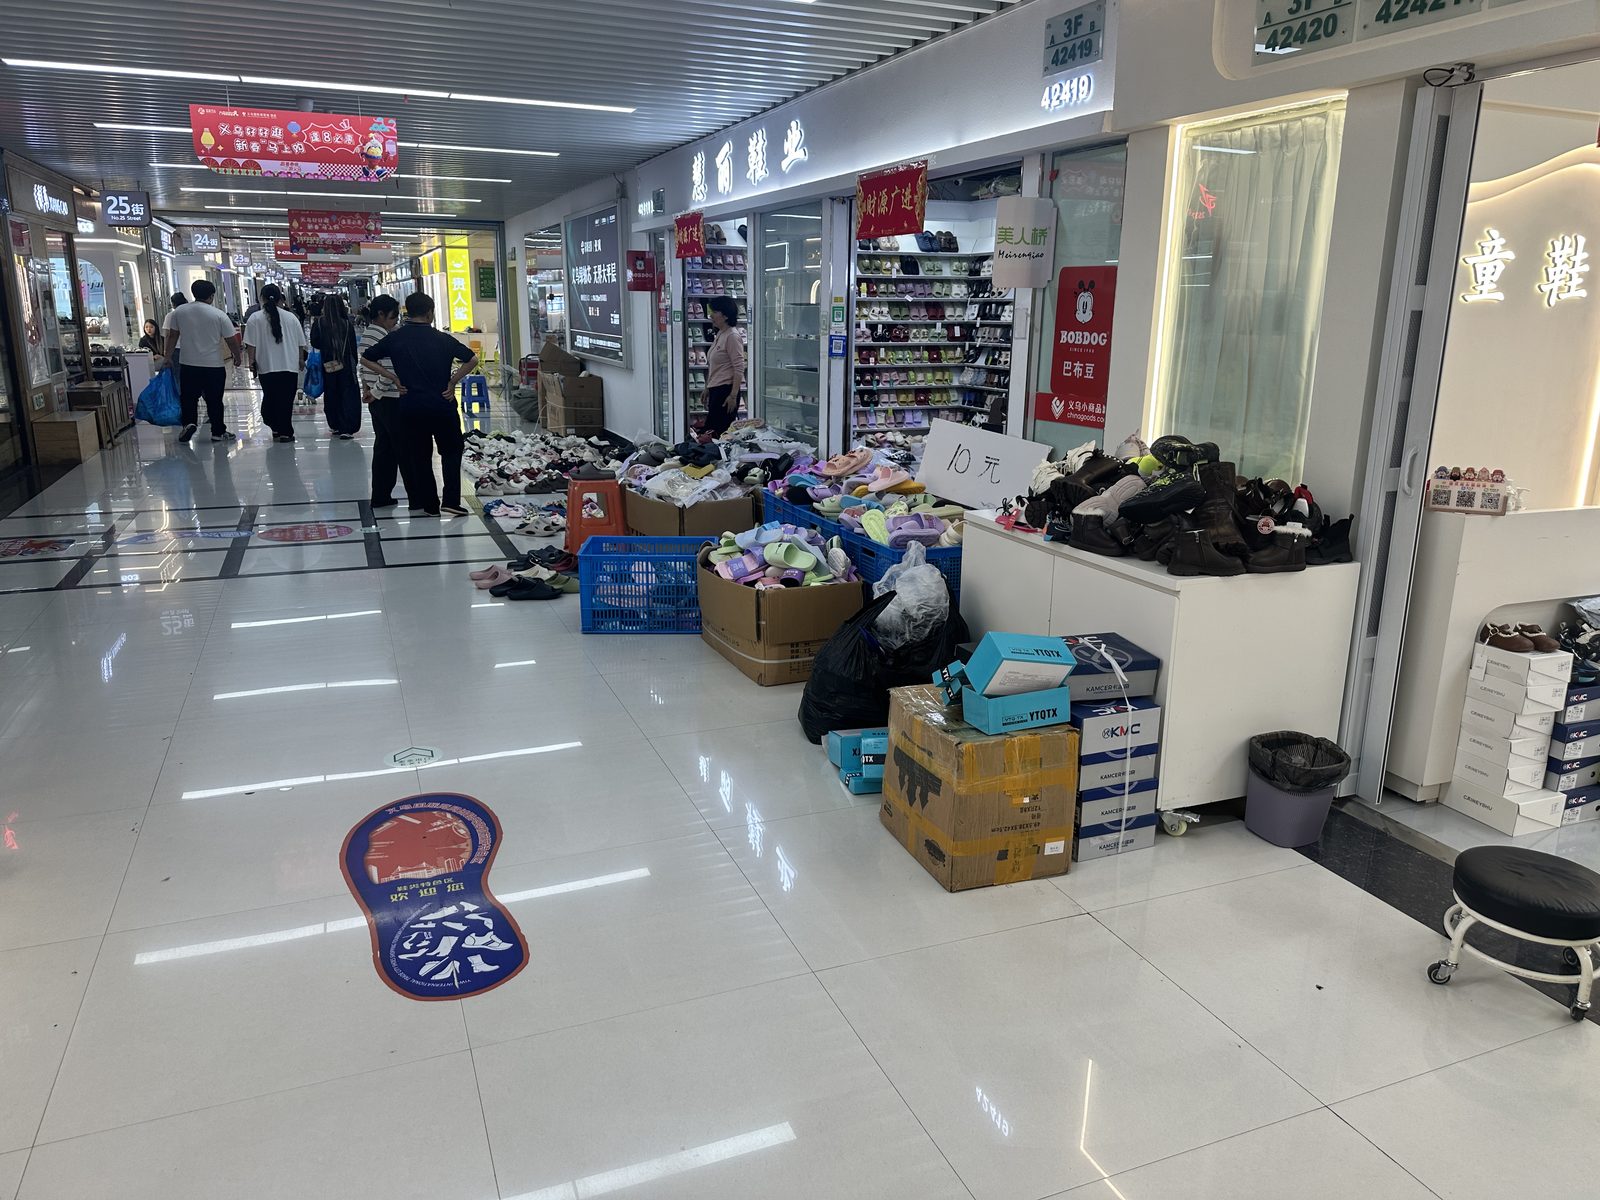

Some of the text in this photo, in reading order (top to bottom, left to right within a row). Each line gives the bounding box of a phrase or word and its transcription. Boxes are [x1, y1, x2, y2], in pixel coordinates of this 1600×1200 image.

[1264, 11, 1271, 25] A
[1049, 14, 1095, 46] A 3F B
[1265, 13, 1338, 52] 42420
[1051, 38, 1093, 67] 42419
[1041, 74, 1091, 111] 42419
[106, 195, 145, 216] 25街
[866, 182, 914, 218] 财源广进
[997, 226, 1048, 246] 美人桥
[1461, 228, 1590, 308] 童鞋
[1060, 330, 1108, 346] BOBDOG
[1063, 360, 1095, 379] 巴布豆
[1068, 400, 1105, 414] 义乌小商品
[947, 443, 1001, 484] 10元
[1034, 648, 1062, 658] YTQTX
[1029, 707, 1058, 721] YTQTX
[1111, 723, 1141, 738] KMC
